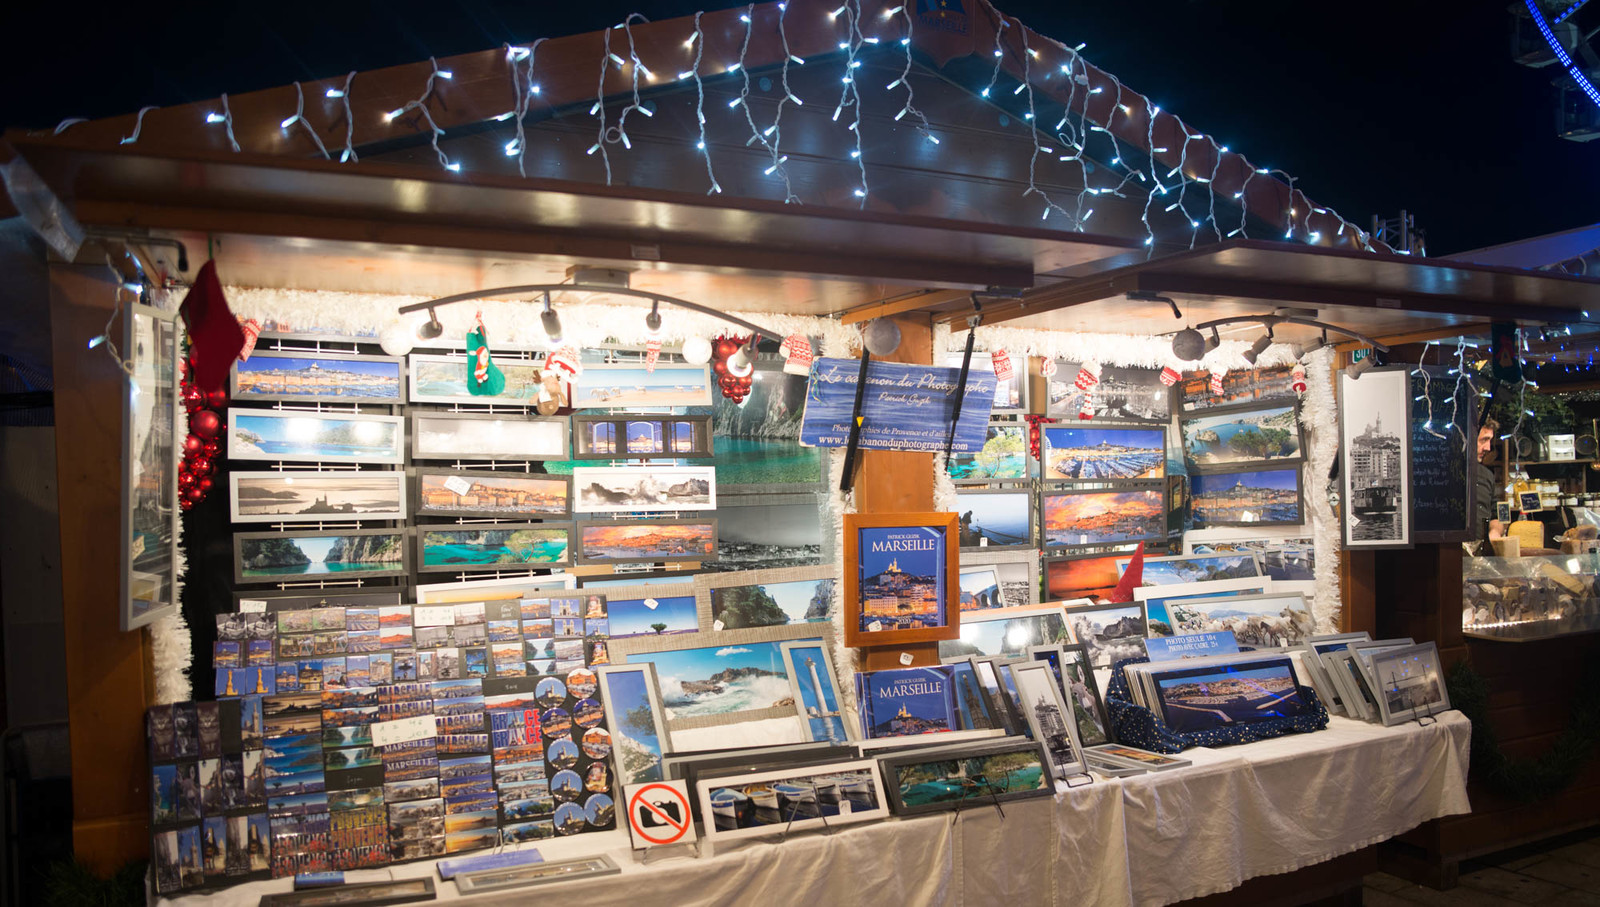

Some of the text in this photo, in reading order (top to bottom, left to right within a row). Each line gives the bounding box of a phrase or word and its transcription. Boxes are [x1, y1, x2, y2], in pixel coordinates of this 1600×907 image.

[819, 365, 990, 396] Le caanon du Photogphe
[832, 424, 880, 435] Photophies
[881, 426, 890, 435] de
[891, 427, 920, 436] Provence
[819, 436, 968, 450] www.labanonduphotographecom
[872, 539, 935, 552] MARSEILLE
[1165, 637, 1185, 645] PHOTO
[880, 681, 942, 698] MARSEILLE
[492, 708, 541, 730] FRANCE
[493, 727, 542, 748] FRANCE
[386, 757, 435, 771] MARSEILLE
